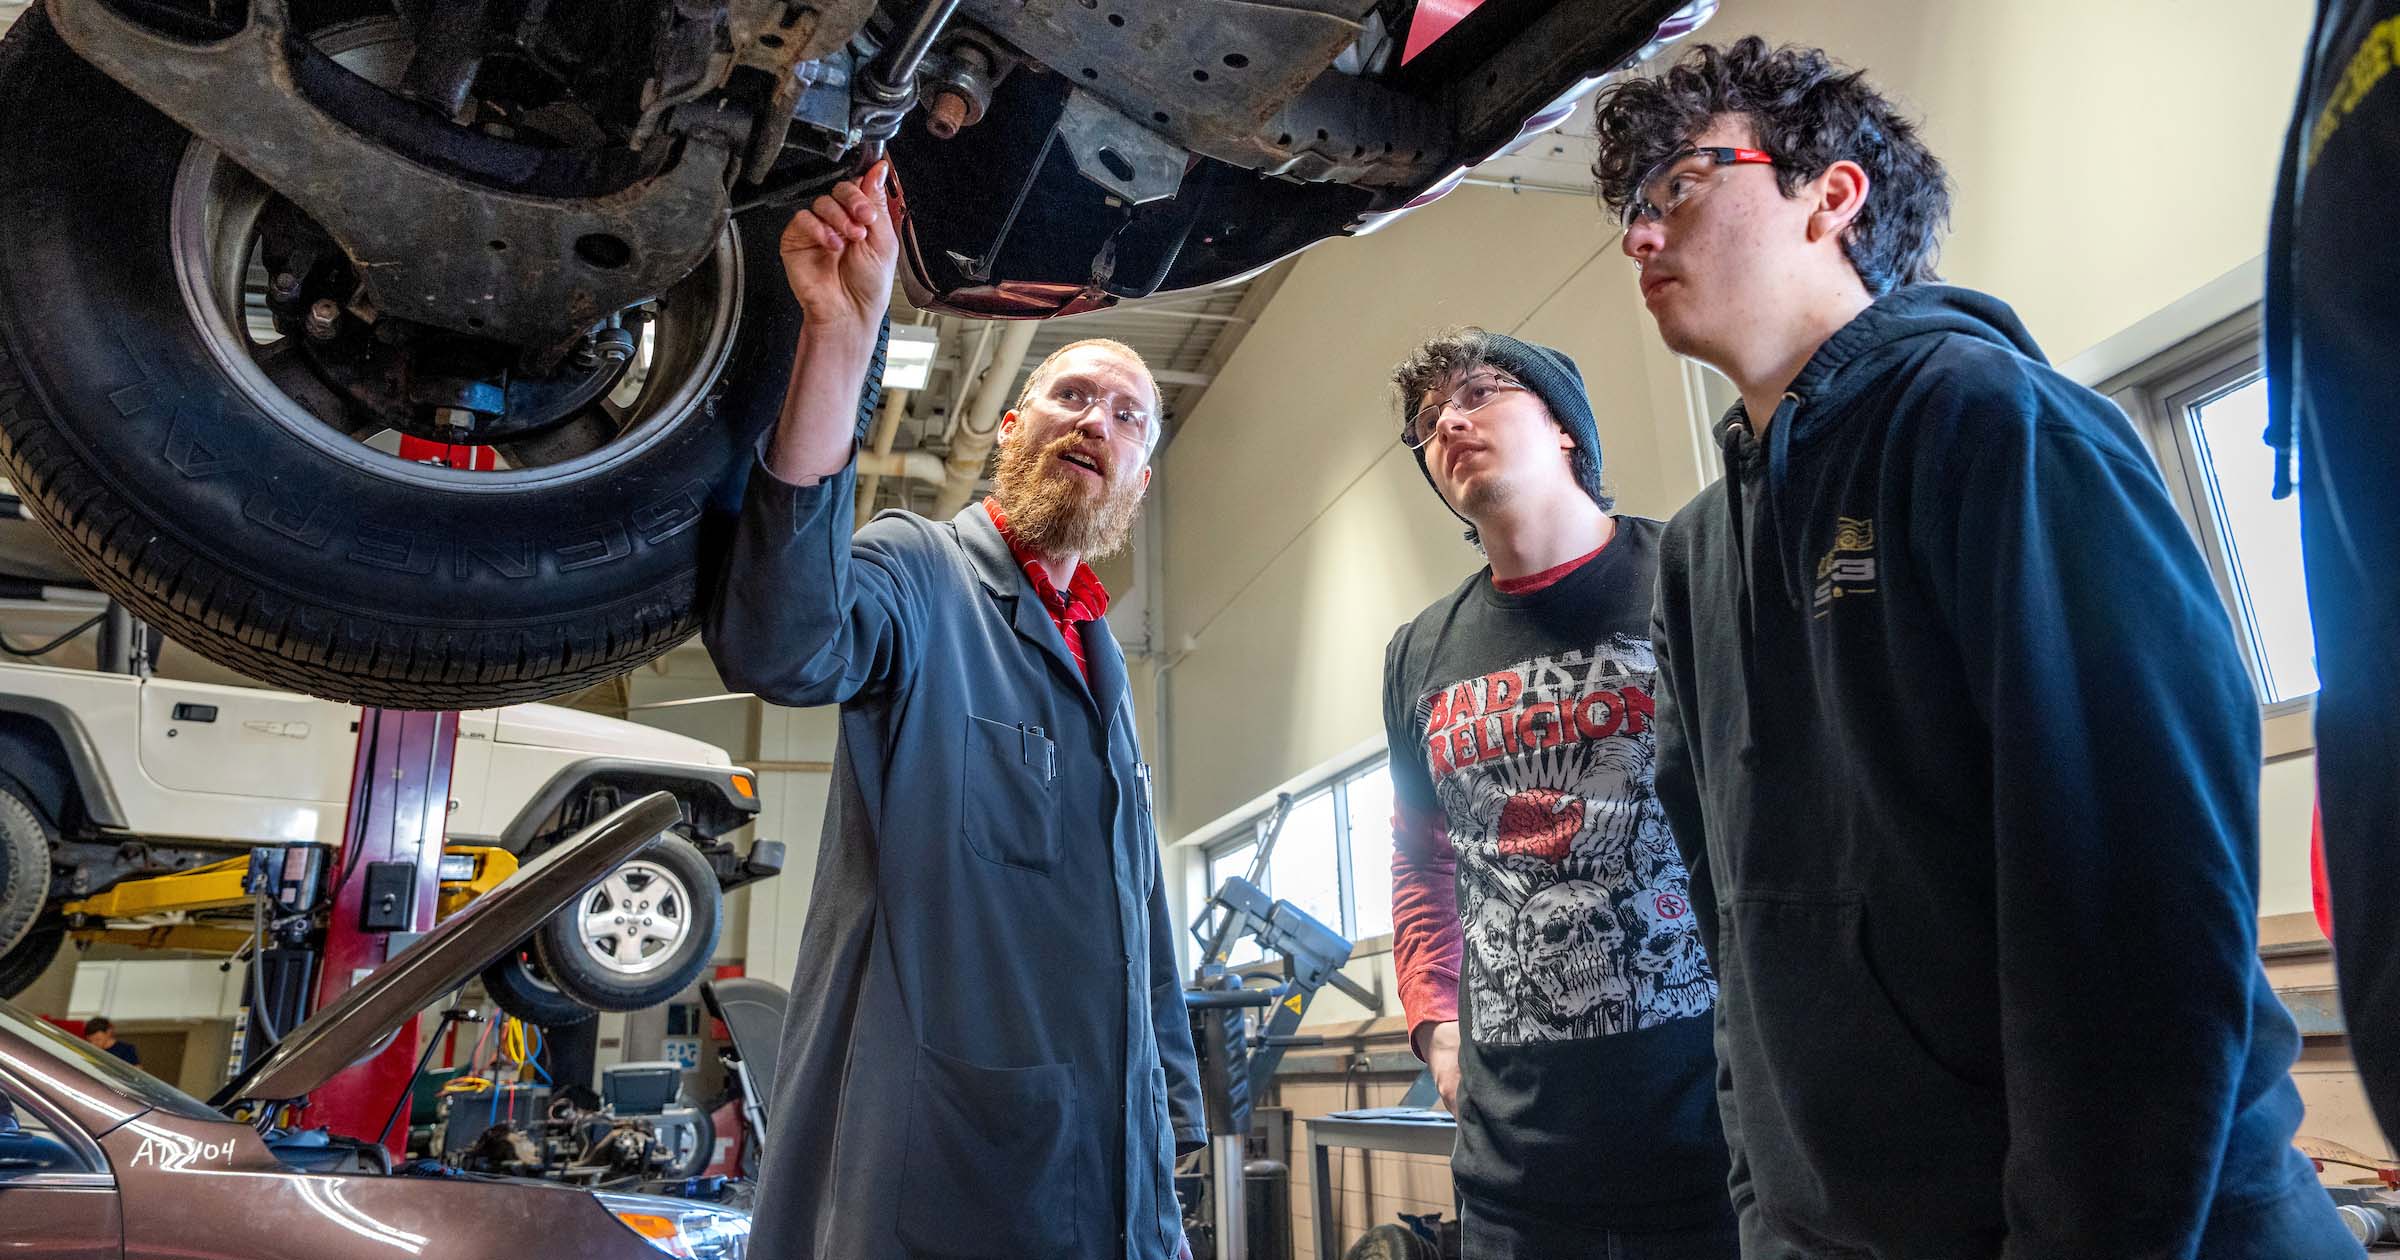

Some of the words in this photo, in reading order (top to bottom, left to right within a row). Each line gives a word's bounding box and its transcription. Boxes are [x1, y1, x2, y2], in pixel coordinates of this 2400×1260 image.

[107, 326, 711, 578] GENERAL
[1428, 671, 1524, 736] BAD
[1428, 686, 1655, 785] RELIGION
